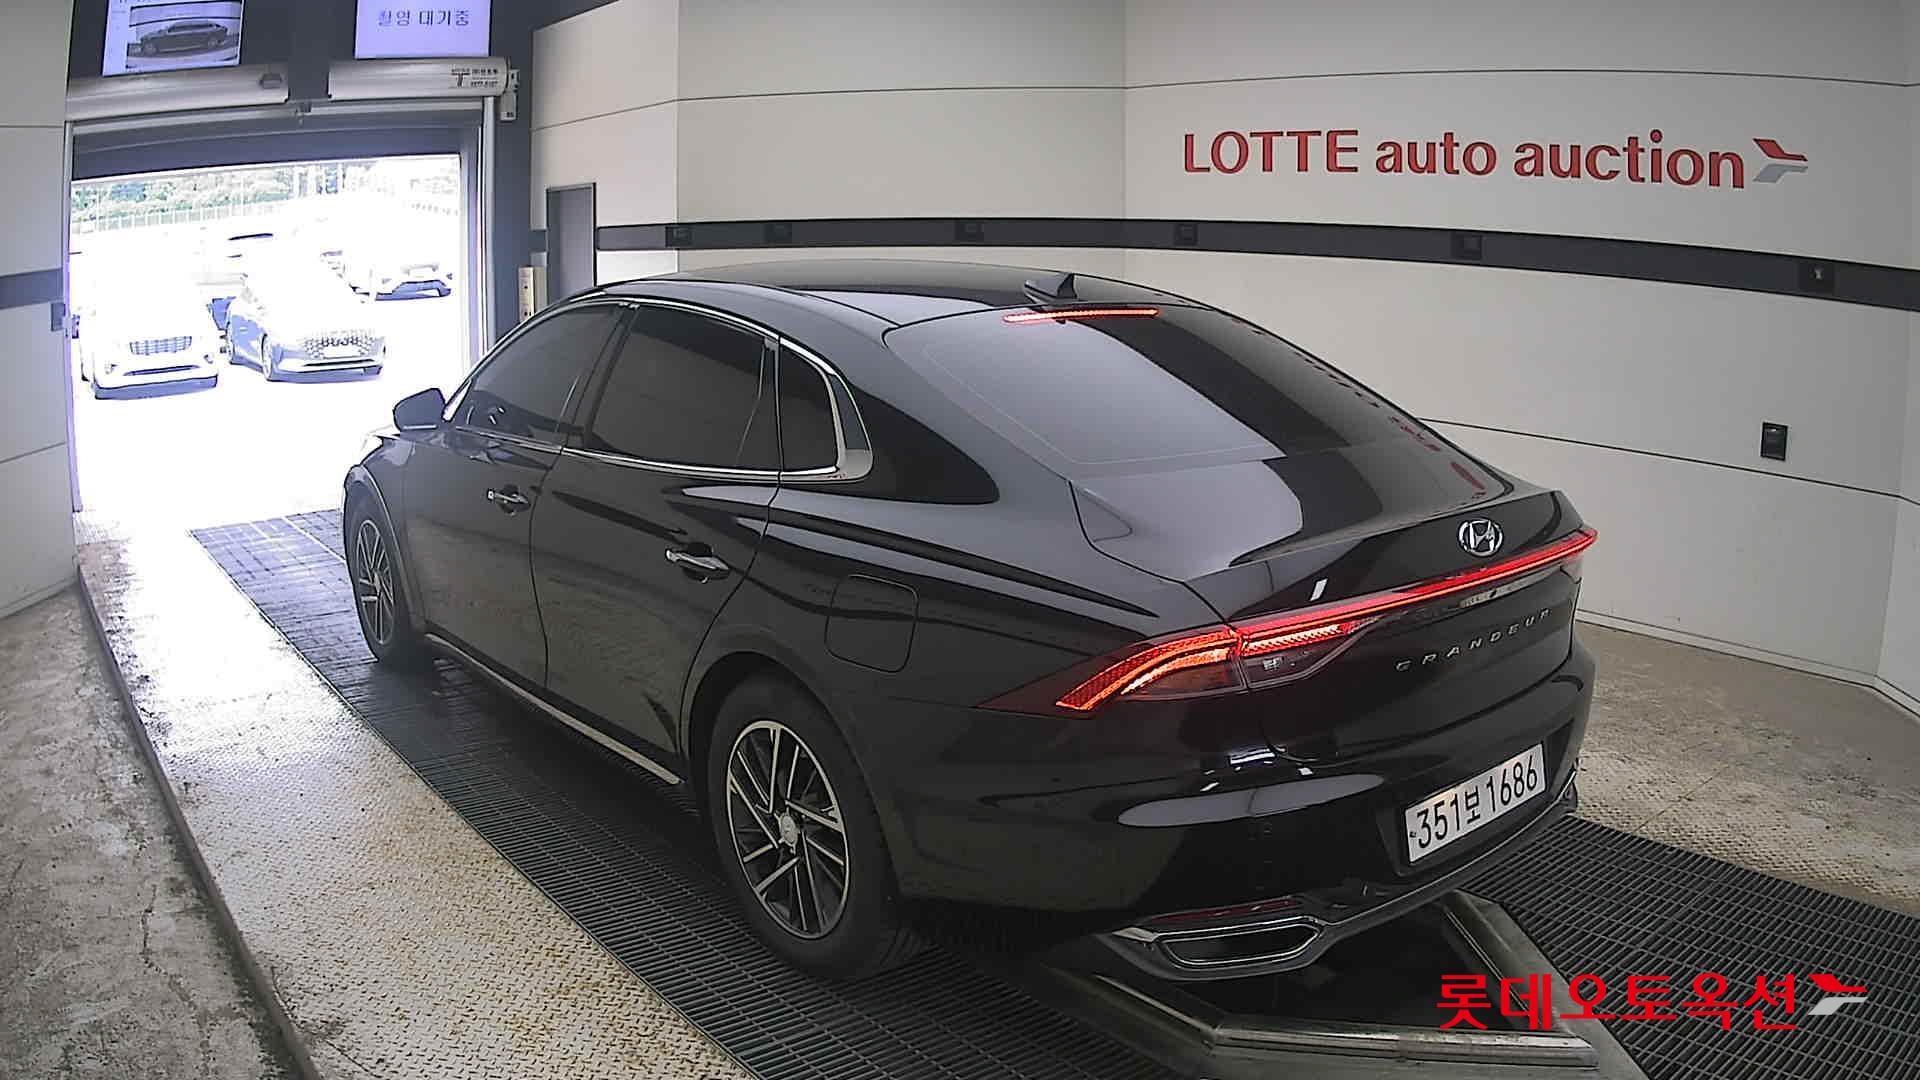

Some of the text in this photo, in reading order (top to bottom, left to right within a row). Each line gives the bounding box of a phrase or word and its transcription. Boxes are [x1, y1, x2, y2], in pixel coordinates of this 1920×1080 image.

[419, 9, 470, 26] 대기중
[1185, 129, 1745, 188] LOTTE auto auction
[1395, 607, 1552, 672] GRANDEUR
